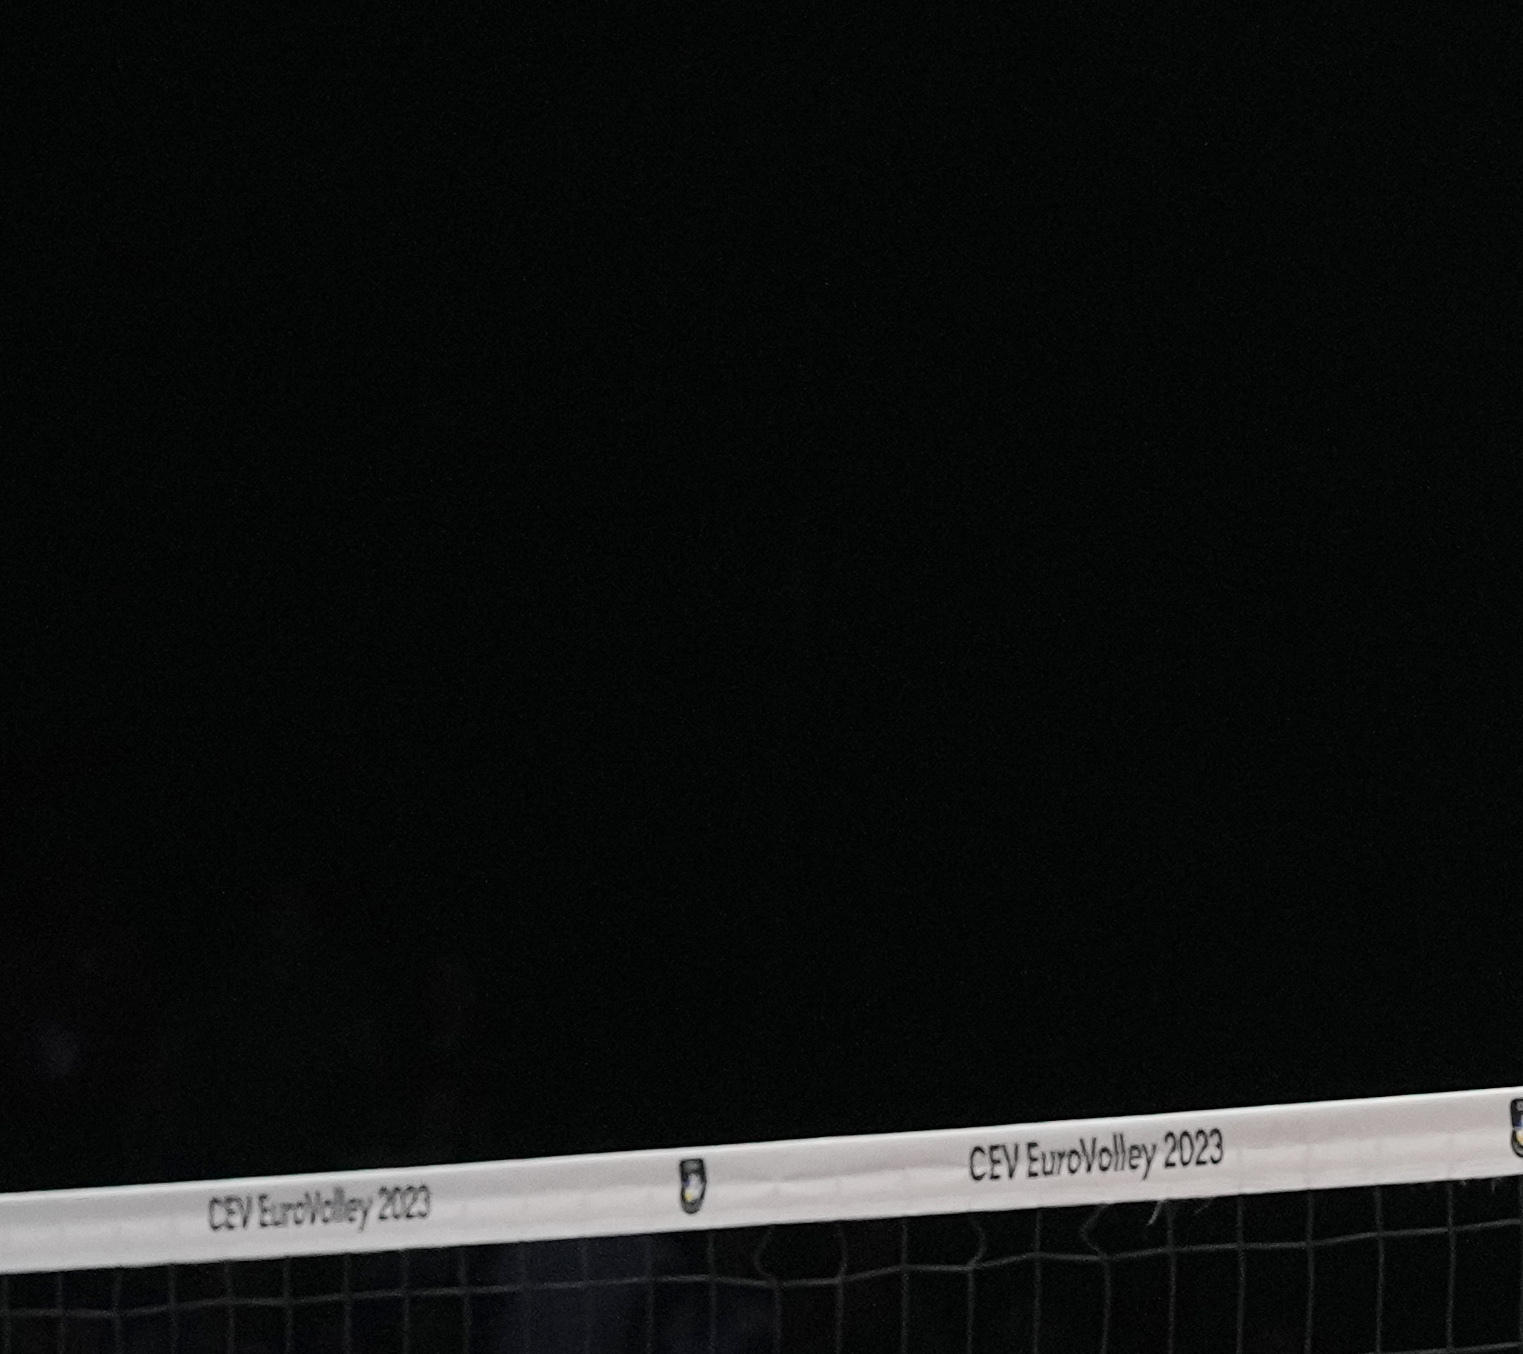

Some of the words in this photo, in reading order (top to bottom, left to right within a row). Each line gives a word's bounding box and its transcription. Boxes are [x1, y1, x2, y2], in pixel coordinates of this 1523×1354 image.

[969, 1143, 1019, 1182] CEV
[1027, 1132, 1157, 1181] EuroVolley
[1164, 1128, 1224, 1168] 2023
[208, 1196, 252, 1232] CEV
[378, 1184, 431, 1221] 2023
